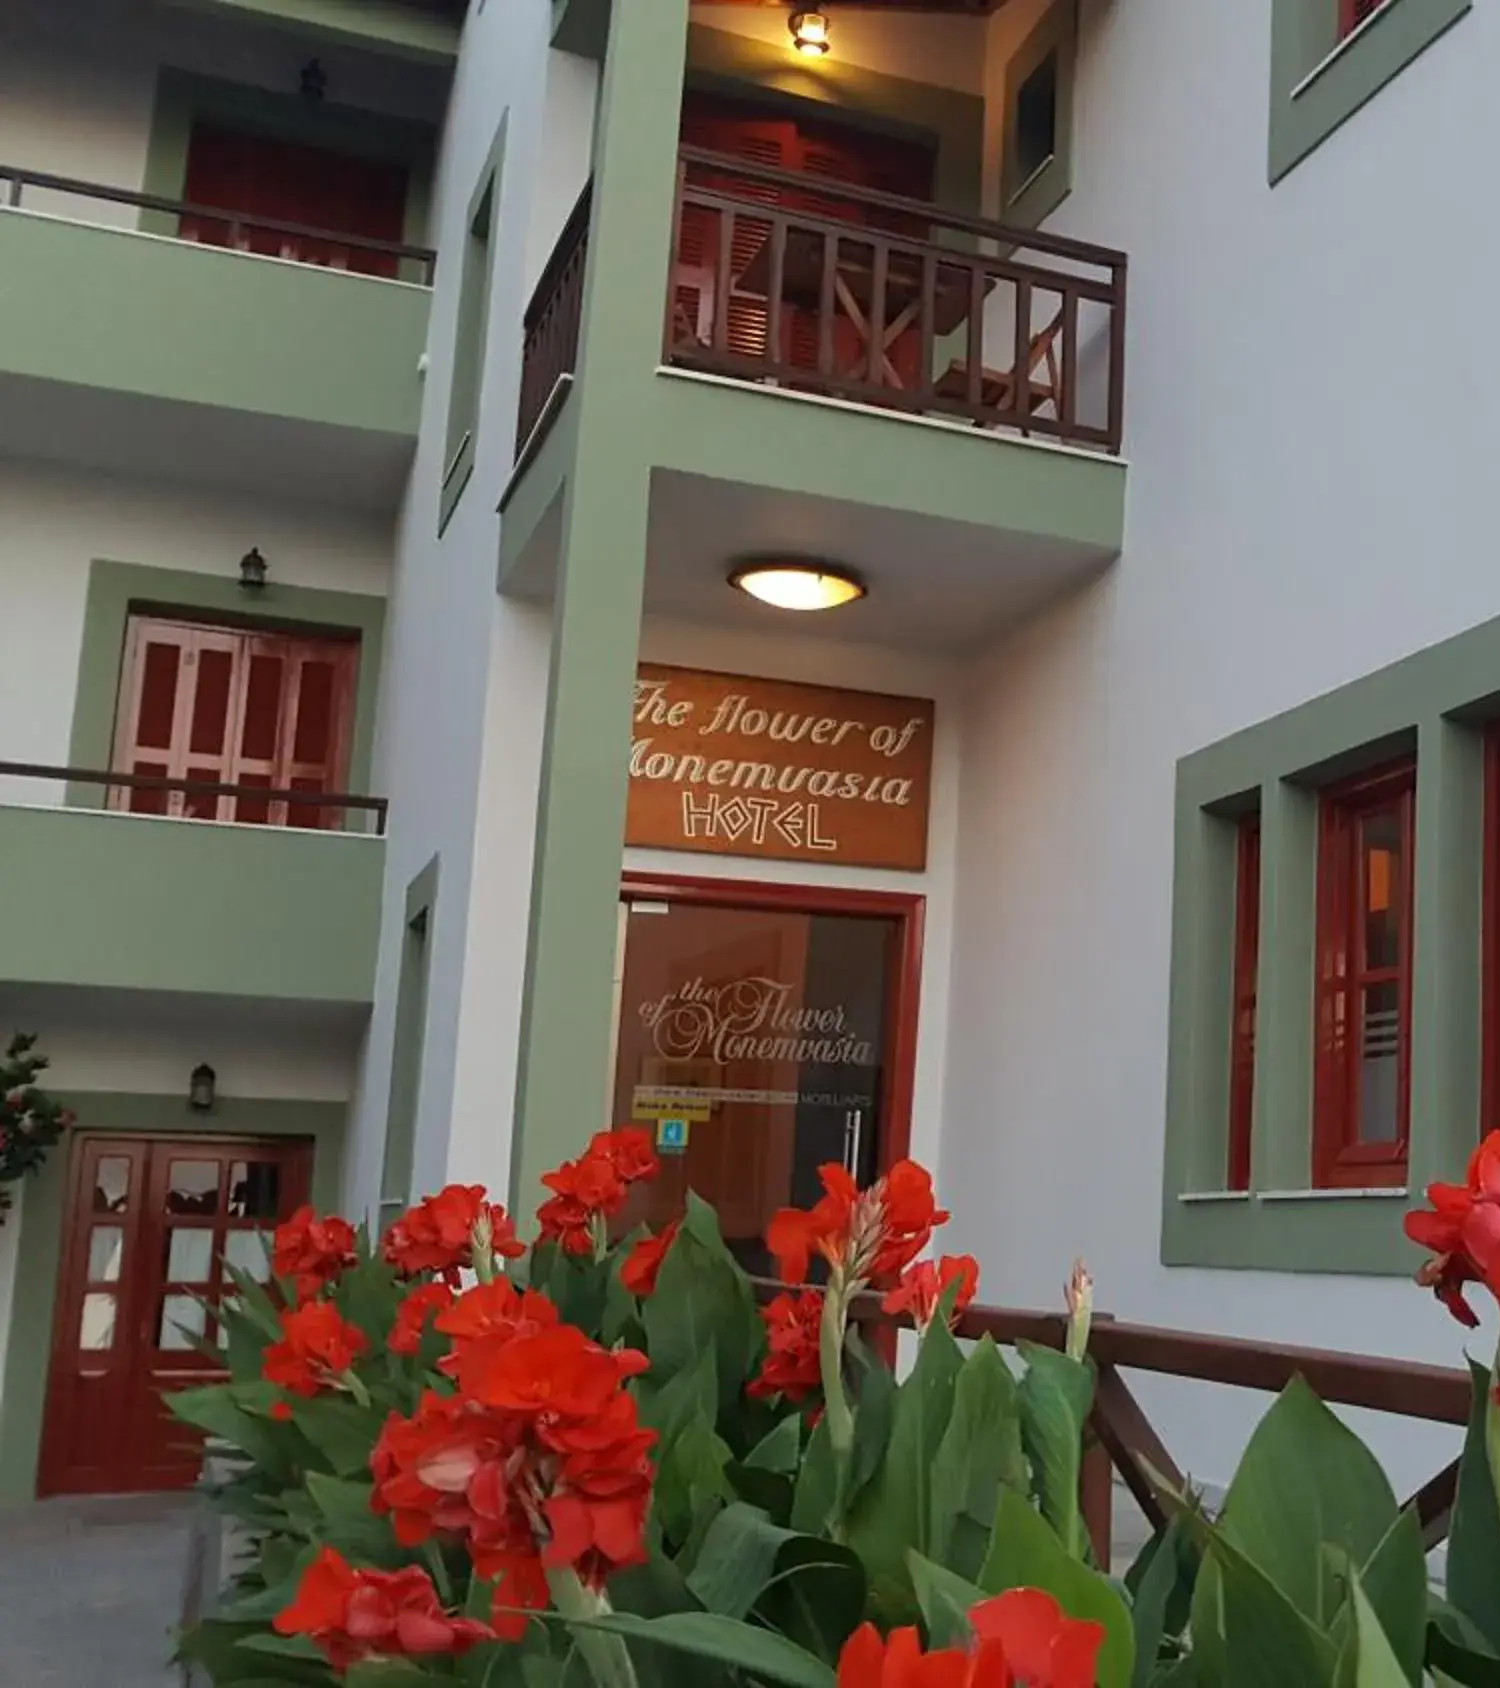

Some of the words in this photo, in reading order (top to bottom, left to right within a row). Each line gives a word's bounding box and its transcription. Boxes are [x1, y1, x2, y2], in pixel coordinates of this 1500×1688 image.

[698, 693, 866, 746] flower
[869, 717, 925, 758] of
[682, 791, 837, 850] HOTEL
[638, 992, 677, 1027] of
[679, 976, 718, 1002] the
[653, 1002, 873, 1065] Monemvasia
